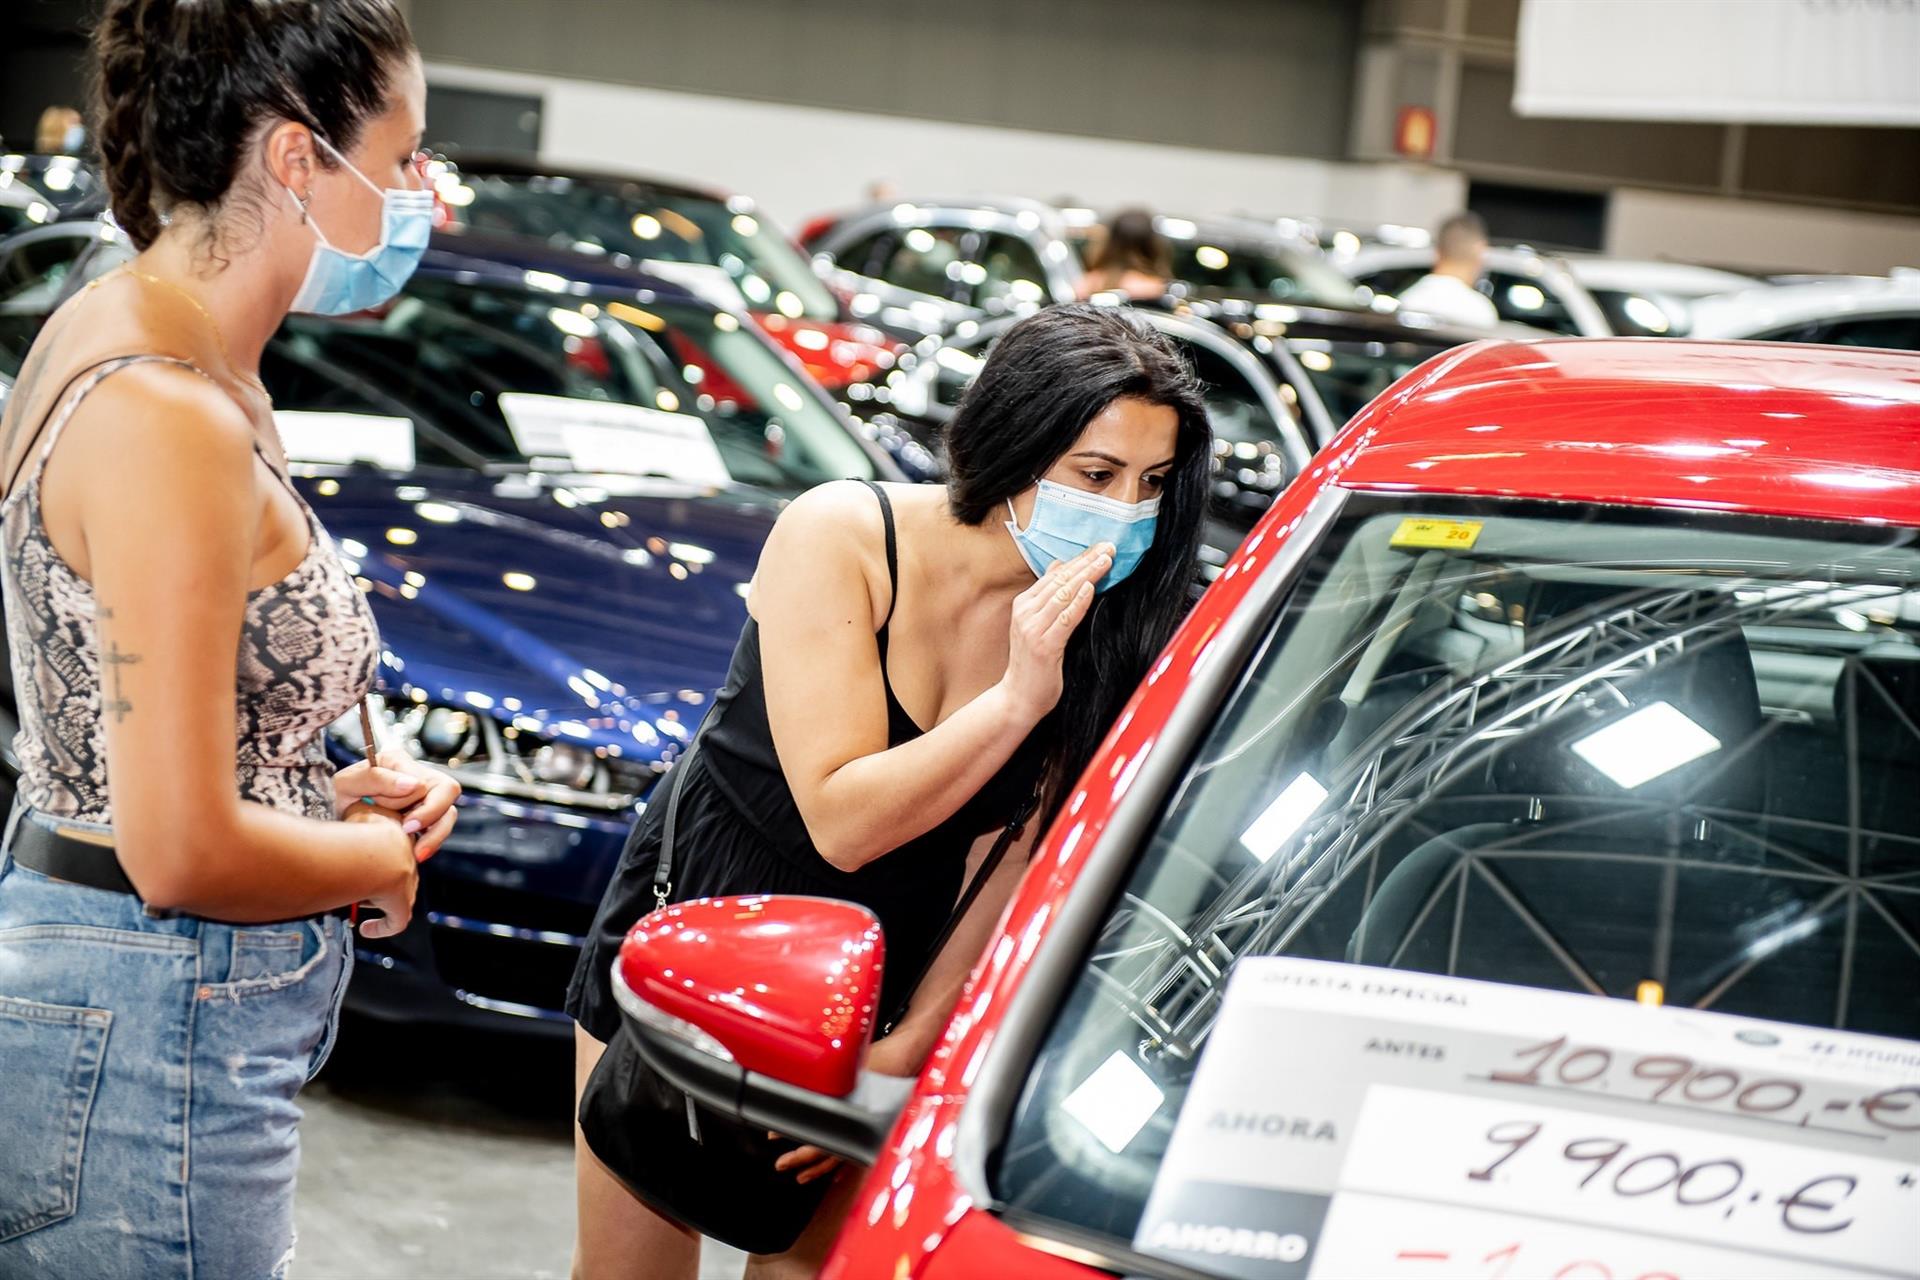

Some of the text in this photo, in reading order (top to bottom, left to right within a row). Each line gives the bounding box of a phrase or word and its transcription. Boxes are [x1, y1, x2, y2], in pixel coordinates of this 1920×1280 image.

[1446, 529, 1470, 540] 20
[1362, 1035, 1447, 1062] ANTES
[1208, 1109, 1338, 1141] AHORA
[1152, 1221, 1309, 1263] AHORRO
